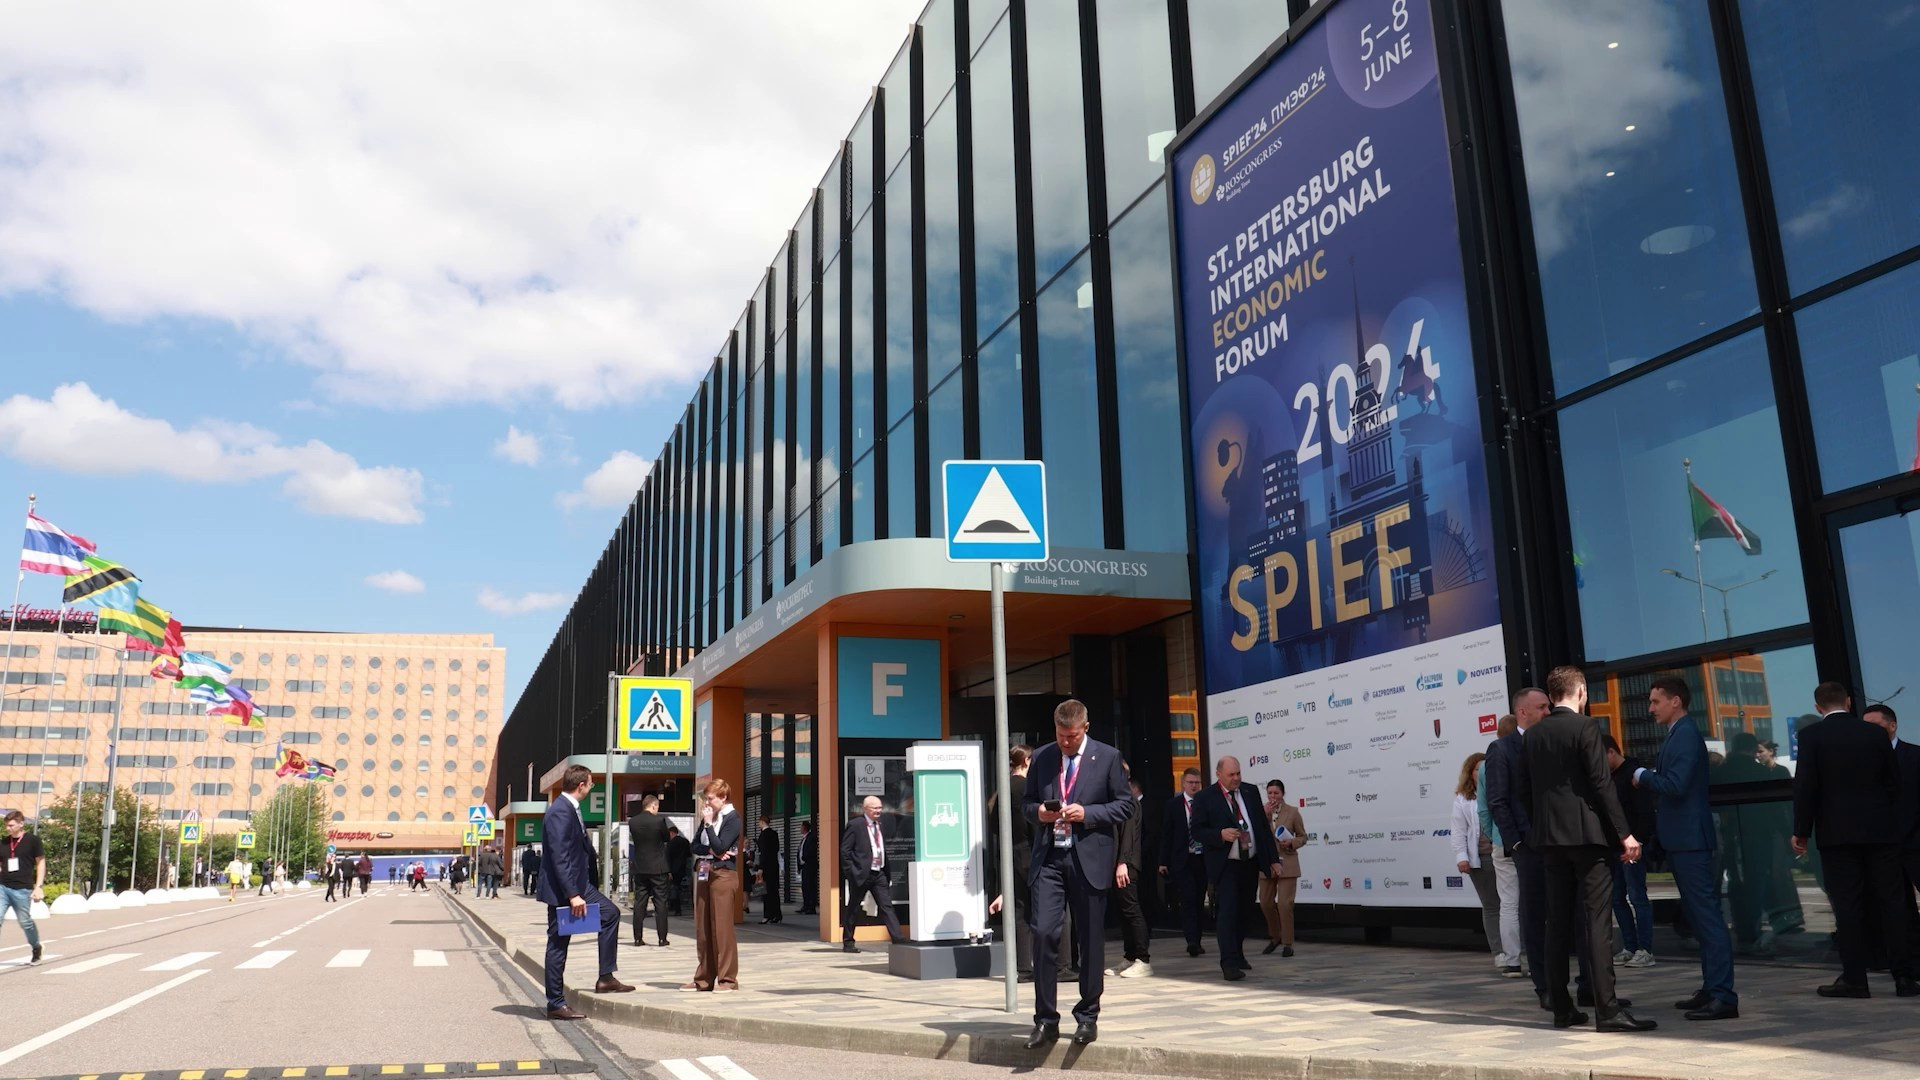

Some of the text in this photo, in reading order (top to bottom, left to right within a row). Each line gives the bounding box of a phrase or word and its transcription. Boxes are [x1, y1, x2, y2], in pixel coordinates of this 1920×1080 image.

[1364, 33, 1412, 91] JUNE
[1225, 137, 1283, 191] ROSCONGRESS
[1207, 136, 1374, 281] ST. PETERSBURG
[1211, 169, 1391, 315] INTERNATIONAL
[1213, 249, 1327, 348] ECONOMIC
[1215, 314, 1289, 382] FORUM
[1293, 319, 1440, 464] 2024
[1023, 558, 1148, 577] ROSCONGRESS
[1024, 575, 1080, 587] Building Trust
[1229, 503, 1411, 651] SPIEF
[1470, 665, 1503, 678] NOVATEK
[872, 663, 907, 716] F
[1372, 685, 1406, 699] GAZPROMBANK
[1303, 702, 1316, 713] VTB
[1263, 709, 1289, 721] ROSATOM
[1370, 733, 1397, 743] AEROFLOT
[1257, 755, 1269, 764] PSB
[1292, 748, 1311, 760] SBER
[590, 792, 605, 813] E
[1361, 793, 1378, 803] hyper
[327, 829, 375, 842] Hampton
[525, 823, 534, 837] E
[1355, 832, 1384, 840] URALCHEM
